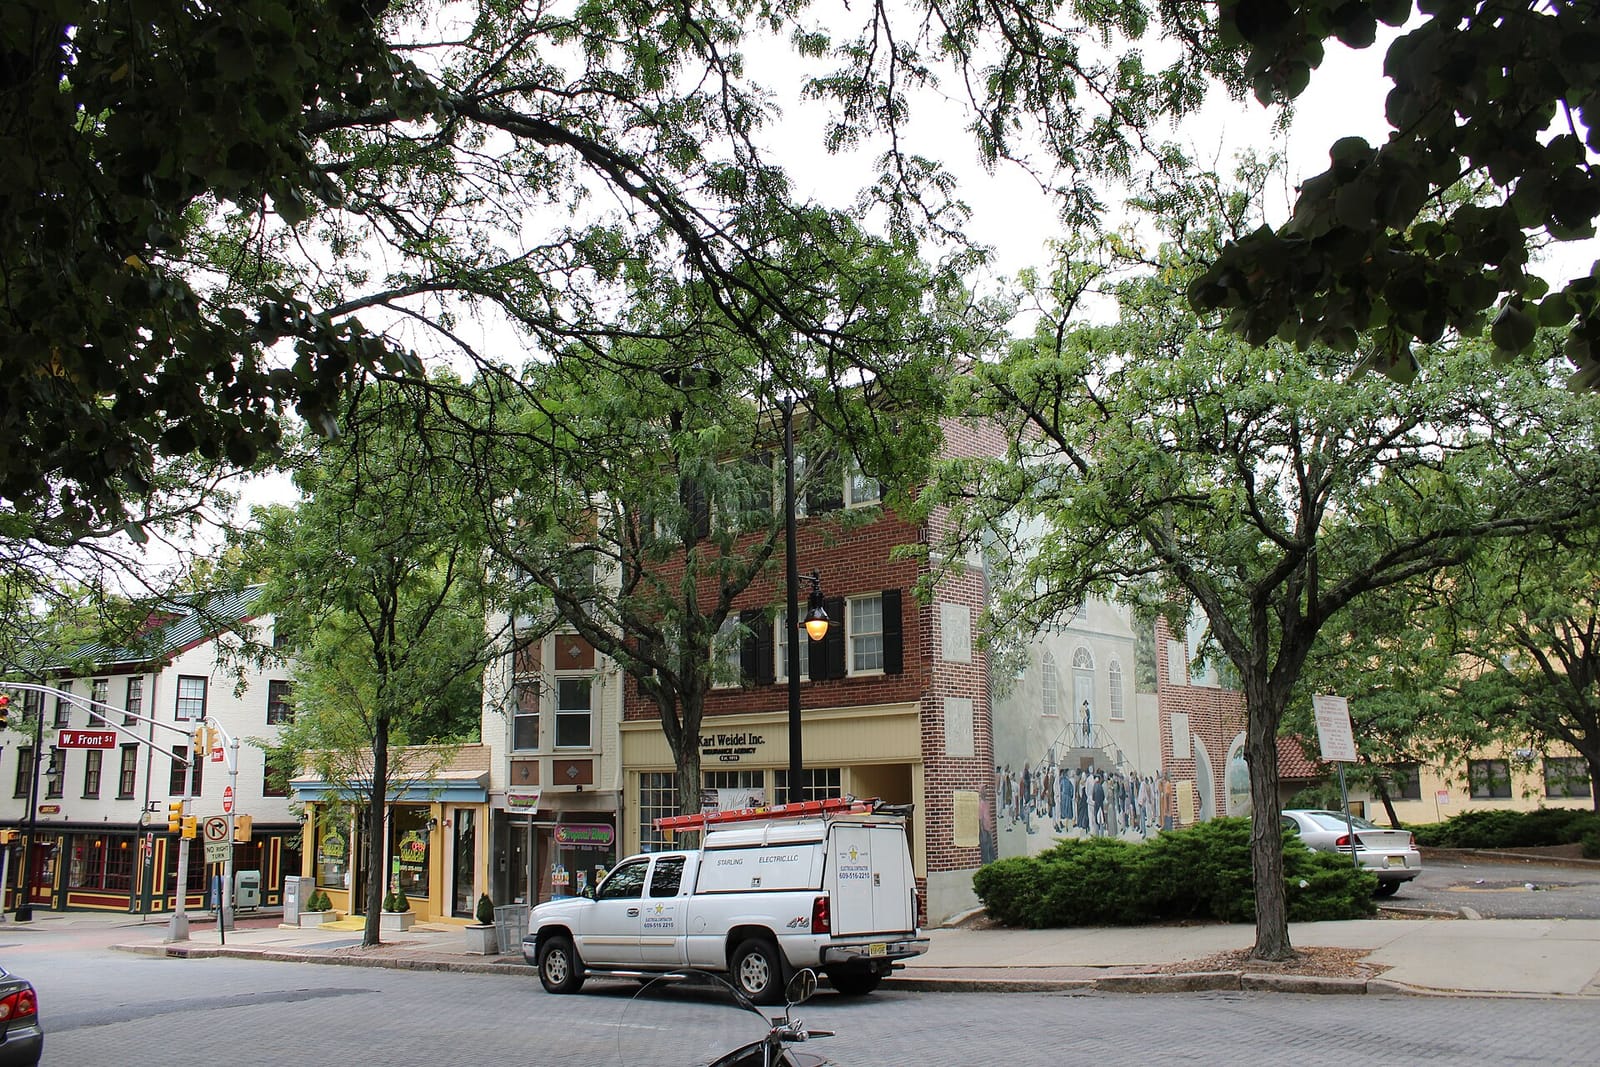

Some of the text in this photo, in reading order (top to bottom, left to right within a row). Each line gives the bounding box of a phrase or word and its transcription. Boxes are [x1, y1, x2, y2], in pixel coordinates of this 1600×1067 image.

[63, 734, 74, 744] W.
[78, 734, 102, 745] Front
[697, 732, 766, 747] Karl Weidel Inc.
[717, 858, 743, 866] STARLING
